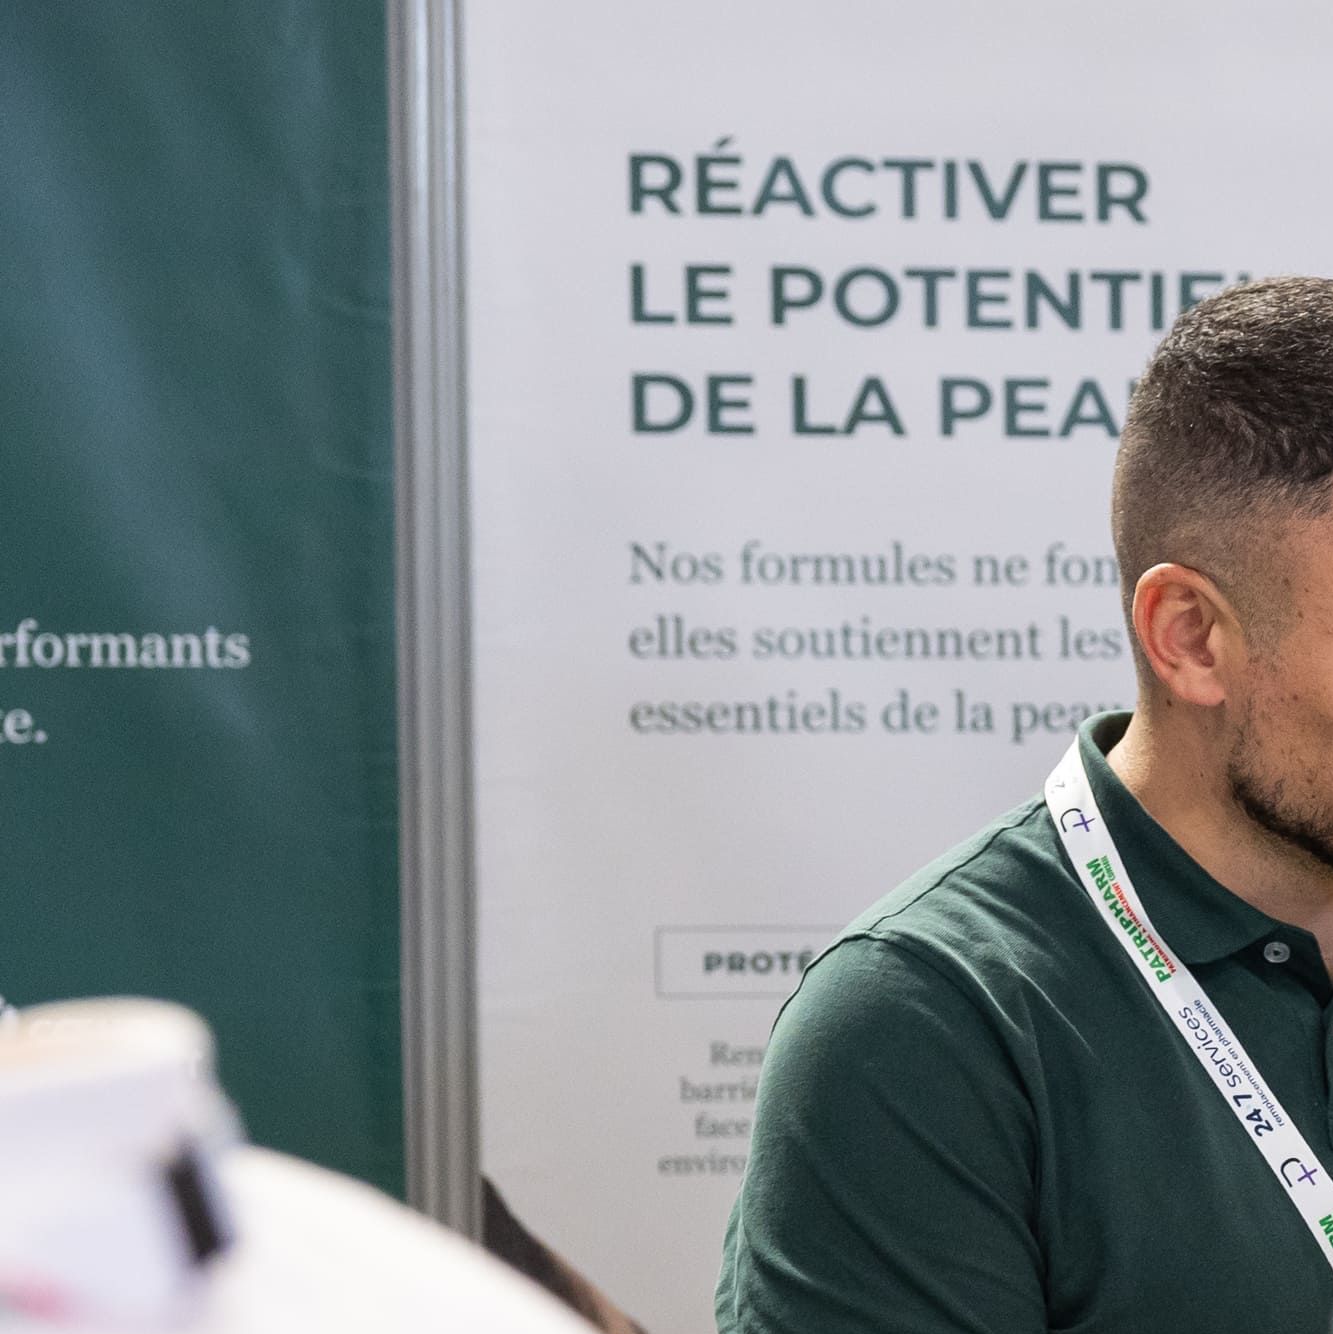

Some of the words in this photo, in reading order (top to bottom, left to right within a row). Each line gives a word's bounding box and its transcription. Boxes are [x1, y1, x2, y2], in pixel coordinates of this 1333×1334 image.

[629, 136, 1149, 223] RÉACTIVER
[630, 264, 733, 325] LE
[771, 266, 1250, 330] POTENTIE
[631, 373, 755, 435] DE
[792, 373, 905, 437] LA
[940, 377, 1137, 438] PEA
[629, 540, 724, 585] Nos
[741, 539, 957, 586] formules
[973, 552, 1029, 587] ne
[629, 614, 738, 660] elles
[752, 615, 1042, 660] soutiennent
[1059, 615, 1123, 660] les
[629, 688, 868, 734] essentiels
[881, 688, 940, 733] de
[955, 688, 995, 733] la
[1086, 857, 1172, 984] PATRIPHARM
[1178, 1006, 1242, 1088] services
[1193, 999, 1232, 1052] pharmacie
[1237, 1060, 1285, 1128] remplacement
[1245, 1107, 1274, 1137] 24
